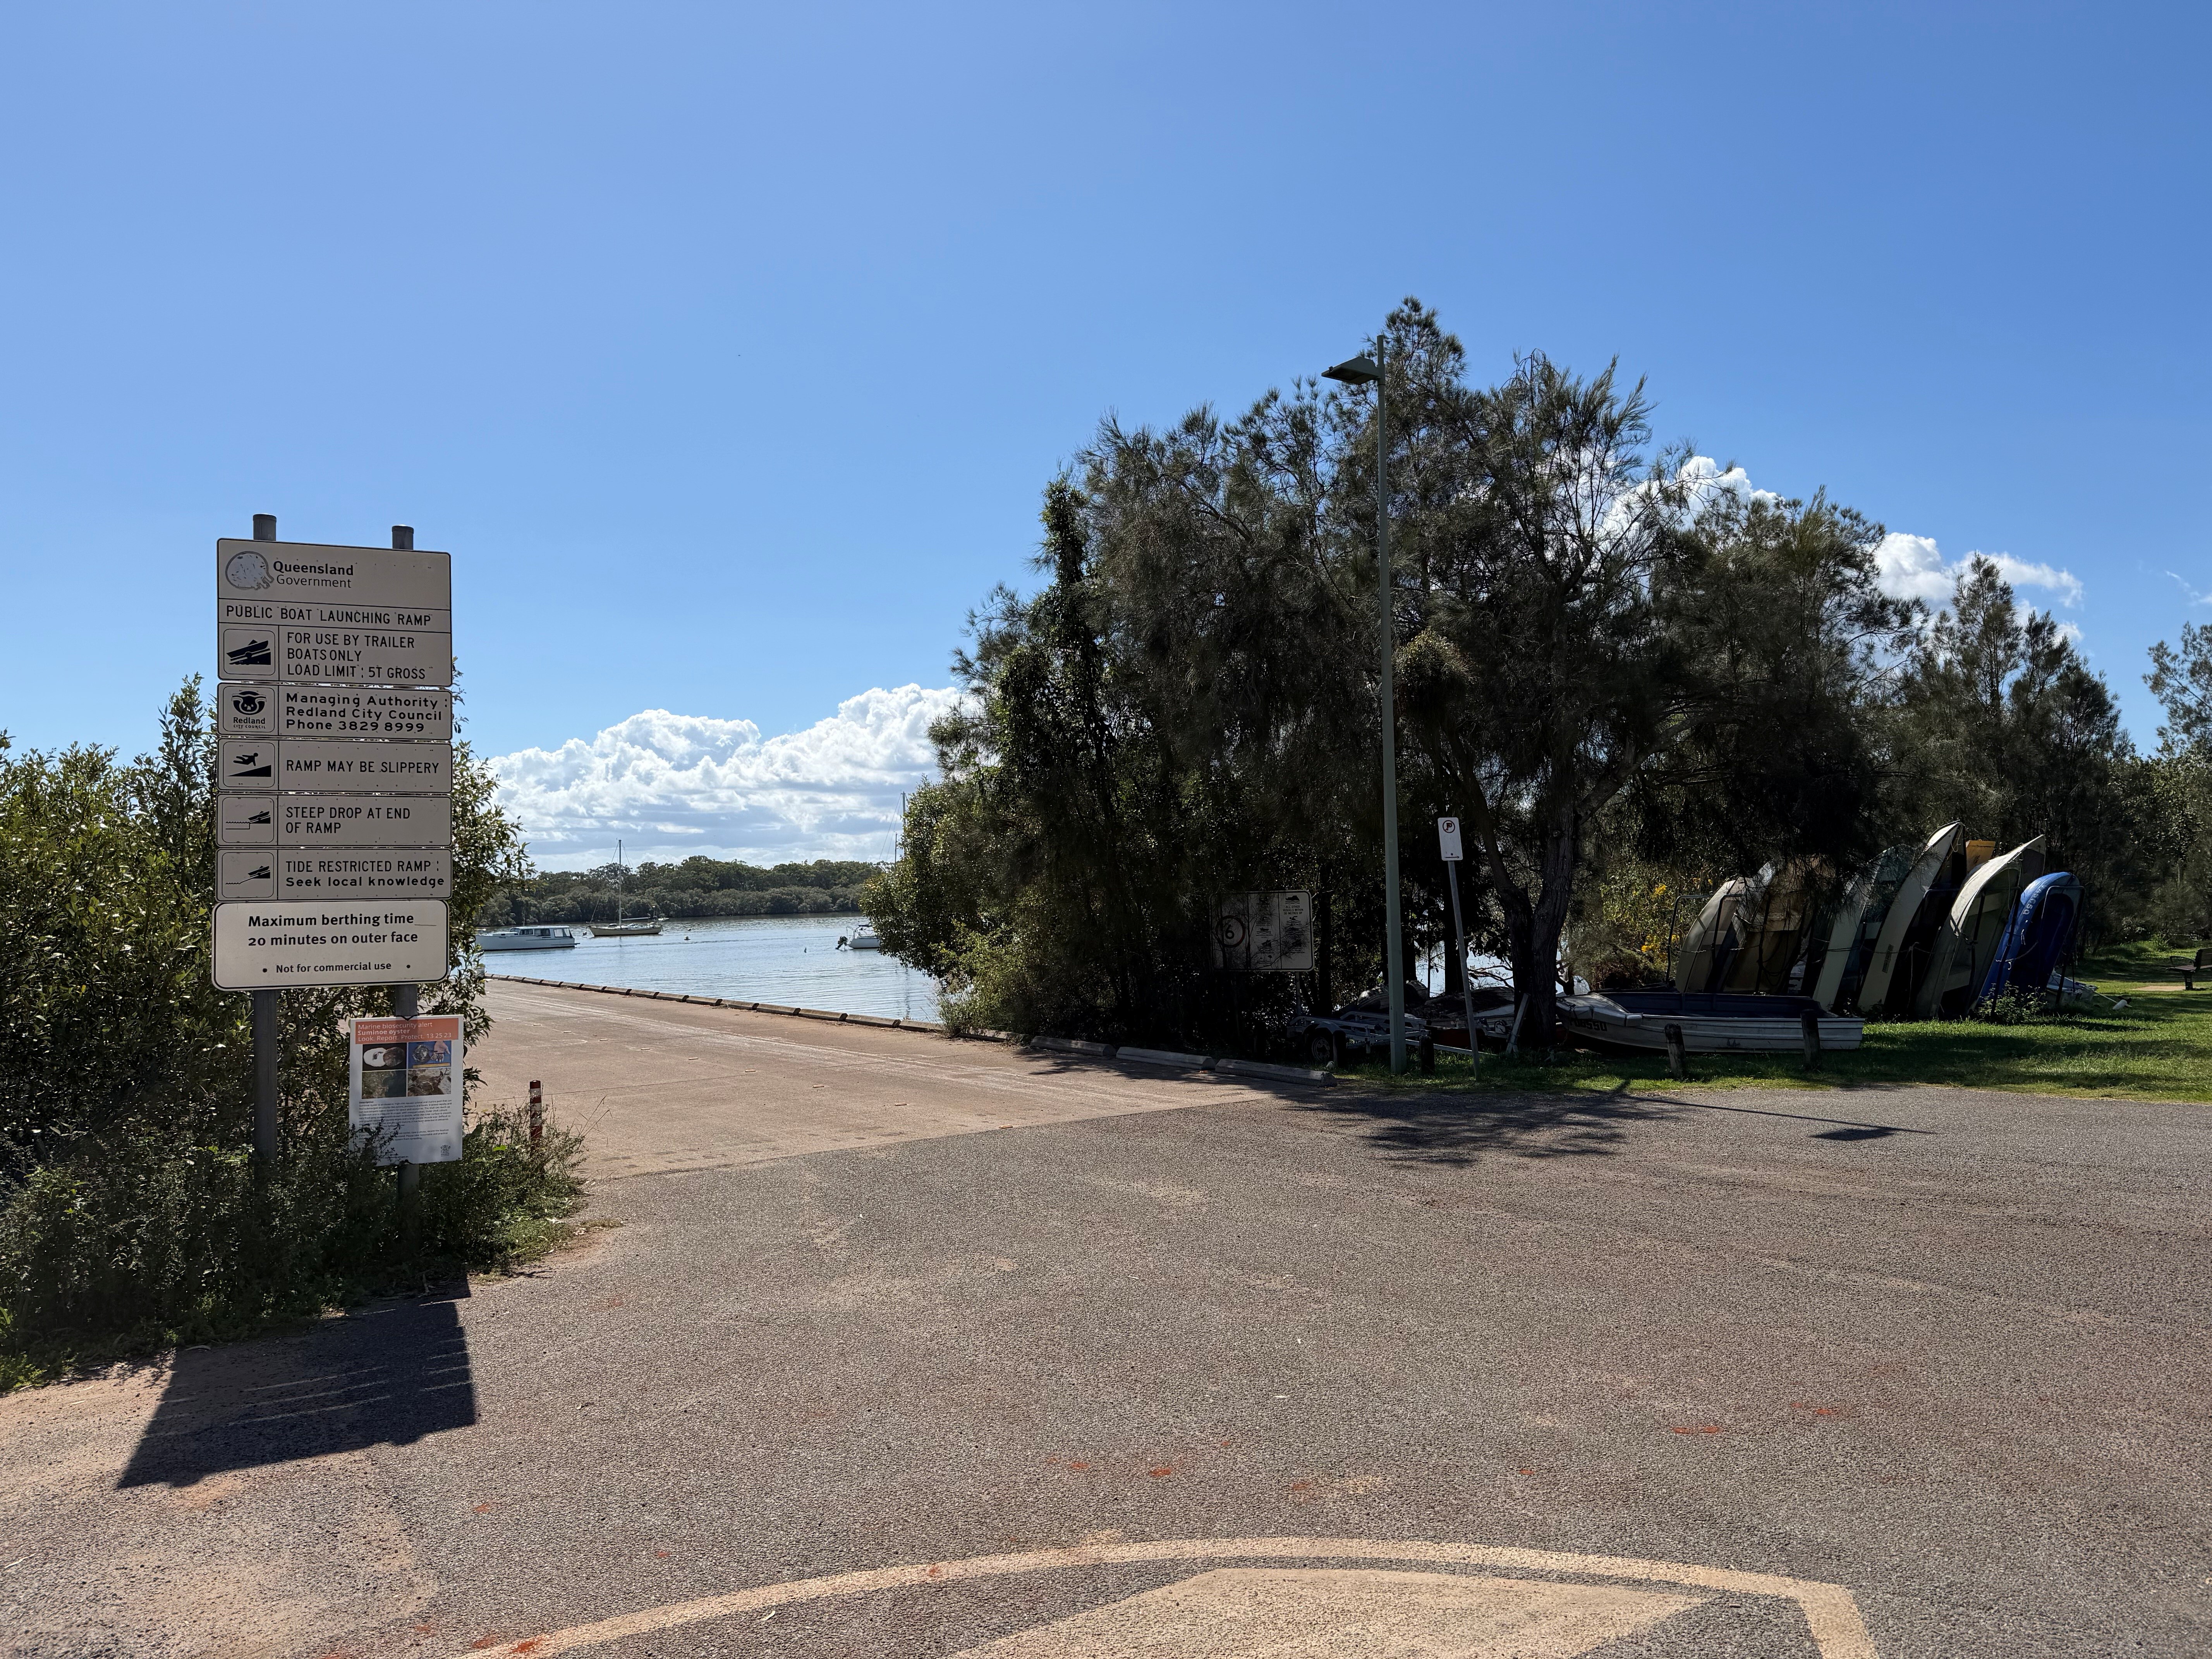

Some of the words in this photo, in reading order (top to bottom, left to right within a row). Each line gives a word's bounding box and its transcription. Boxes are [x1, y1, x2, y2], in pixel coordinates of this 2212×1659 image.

[273, 561, 353, 575] Queensland
[276, 575, 352, 588] Government
[226, 605, 273, 618] PUBLIC
[281, 608, 312, 620] BOAT
[320, 609, 390, 624] LAUNCHING
[398, 614, 431, 626] RAMP
[287, 632, 311, 644] FOR
[316, 634, 338, 646] USE
[344, 635, 359, 646] BY
[364, 635, 415, 648] TRAILER
[287, 648, 327, 660] BOATS
[330, 649, 362, 662] ONLY
[287, 664, 320, 676] LOAD
[369, 666, 382, 678] 5T
[387, 667, 426, 680] GROSS
[287, 693, 360, 707] Managing
[367, 696, 438, 709] Authority
[287, 707, 346, 718] Redland
[352, 709, 382, 721] City
[389, 710, 442, 721] Council
[287, 719, 333, 730] Phone
[338, 721, 379, 732] 3829
[384, 723, 424, 733] 8999
[287, 760, 321, 772] RAMP
[328, 761, 354, 772] MAY
[360, 761, 375, 773] BE
[381, 762, 440, 774] SLIPPERY
[286, 807, 325, 818] STEEP
[330, 807, 362, 819] DROP
[367, 807, 382, 819] AT
[387, 808, 410, 819] END
[286, 822, 301, 833] OF
[307, 822, 341, 833] RAMP
[286, 860, 313, 872] TIDE
[319, 860, 392, 872] RESTRICTED
[397, 860, 431, 871] RAMP
[286, 877, 321, 887] Seek
[328, 876, 362, 886] local
[368, 876, 445, 888] knowledge
[248, 915, 317, 927] Maximum
[321, 914, 381, 927] berthing
[384, 913, 414, 924] time
[248, 937, 266, 946] 20
[271, 934, 327, 946] minutes
[331, 935, 347, 944] on
[352, 932, 387, 943] outer
[391, 931, 418, 942] face
[1225, 924, 1235, 939] 6
[276, 964, 294, 973] Not
[296, 963, 311, 972] for
[314, 962, 371, 972] commercial
[374, 962, 392, 970] use
